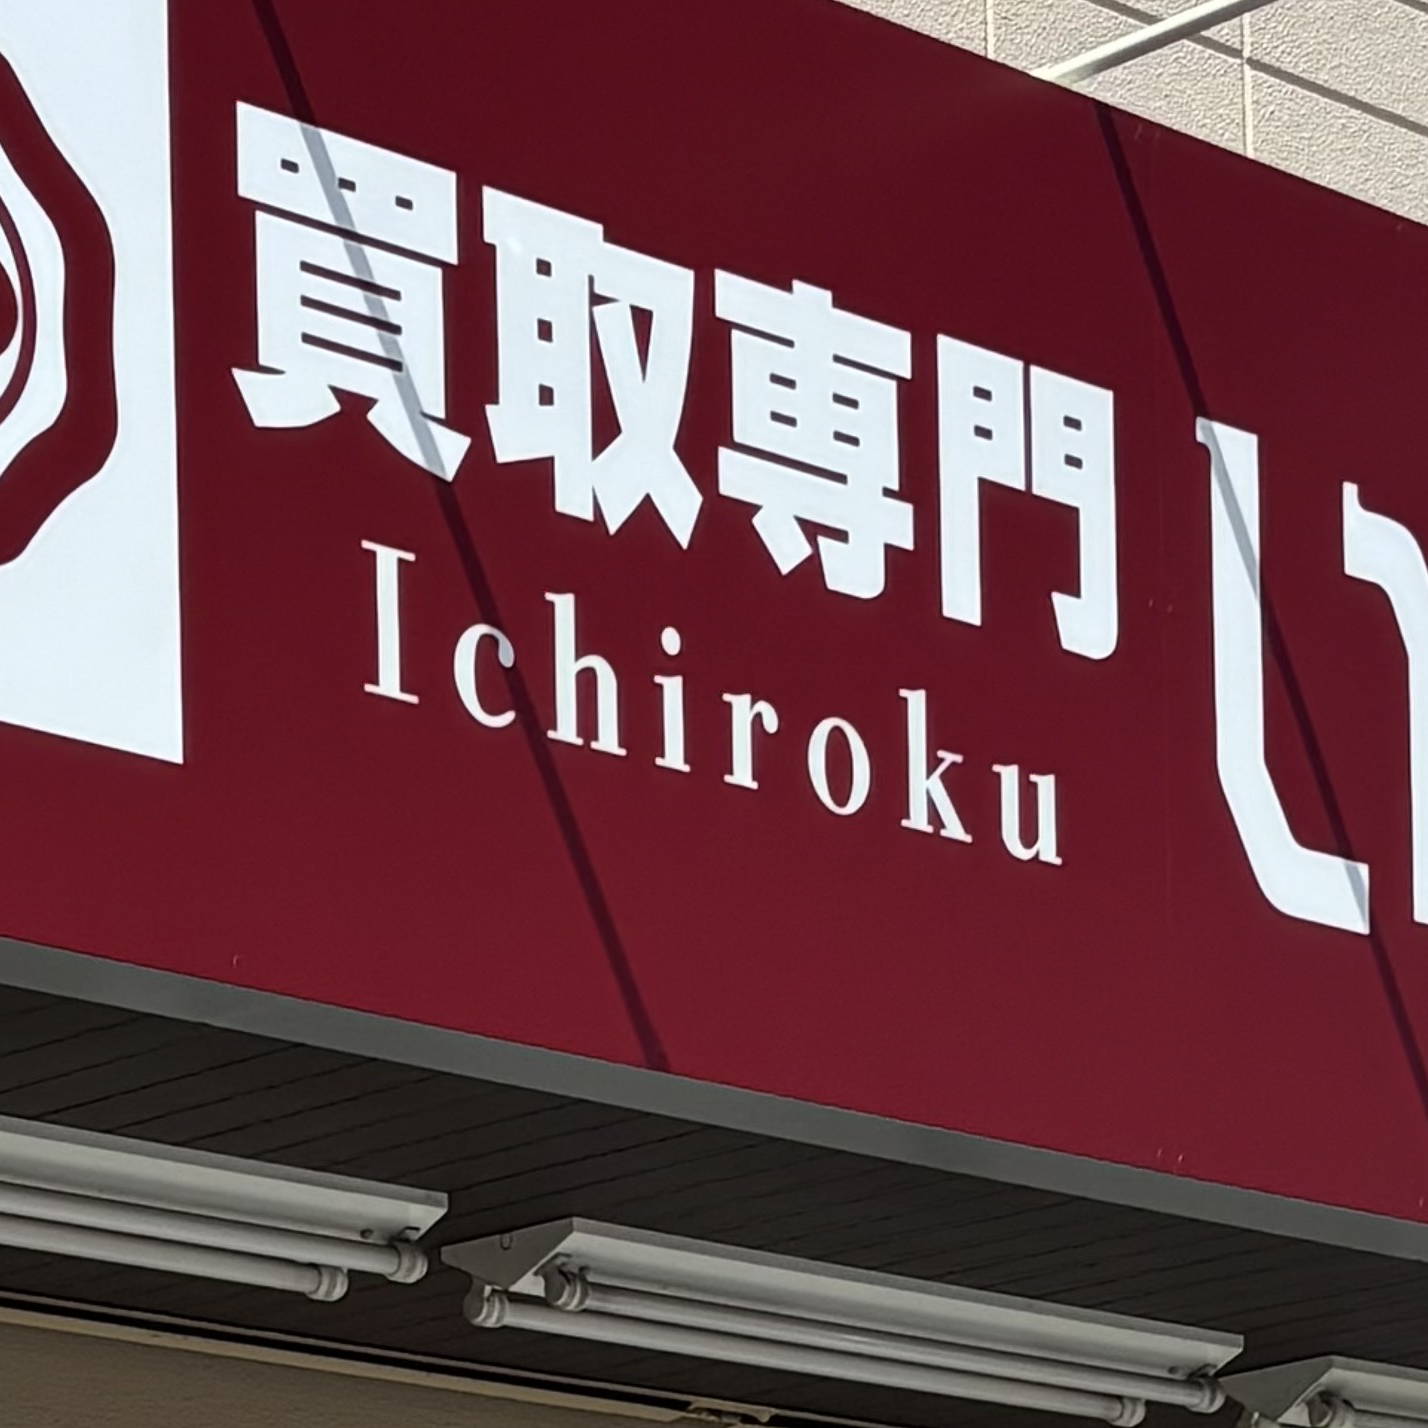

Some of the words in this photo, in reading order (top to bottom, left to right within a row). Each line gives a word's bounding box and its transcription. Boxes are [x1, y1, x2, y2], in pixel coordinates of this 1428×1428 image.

[232, 100, 1120, 661] 買取専門
[361, 538, 1064, 866] Ichiroku
